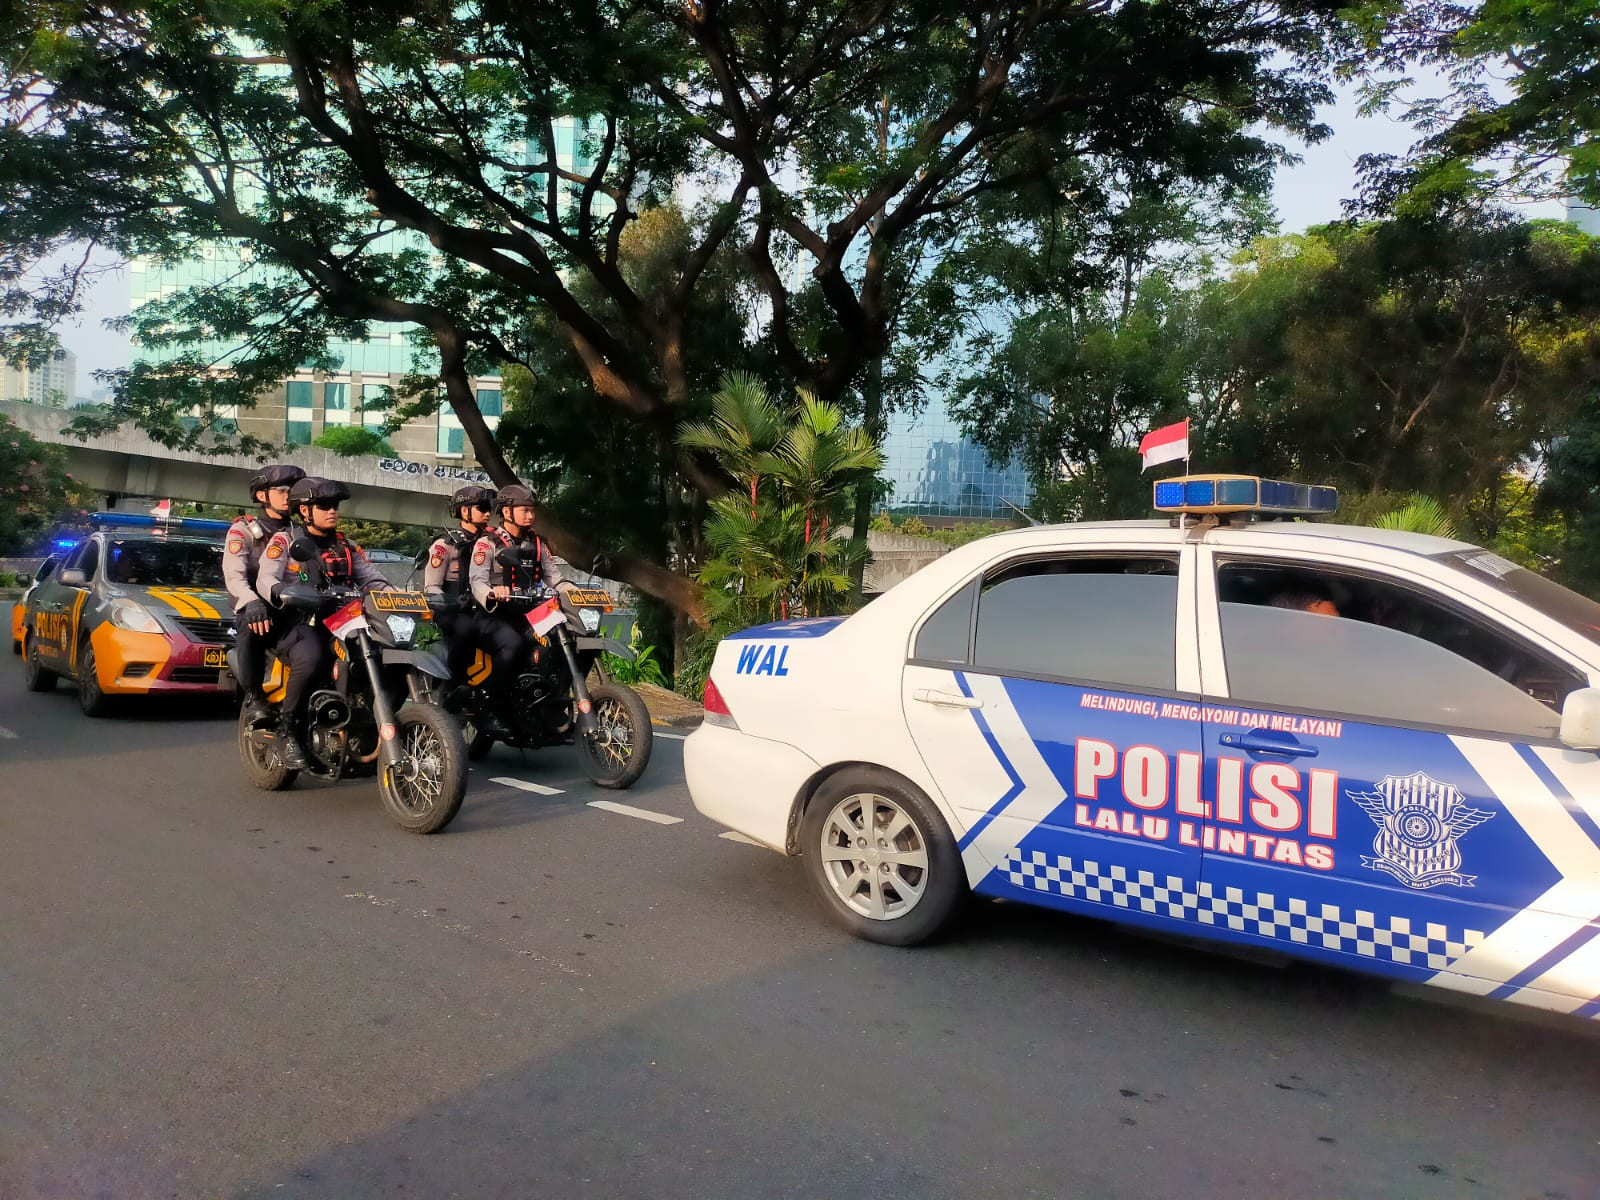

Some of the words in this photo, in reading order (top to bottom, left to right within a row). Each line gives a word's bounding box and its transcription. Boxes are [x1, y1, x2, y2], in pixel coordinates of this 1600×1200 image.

[736, 645, 789, 676] WAL
[1081, 694, 1158, 719] MELINDUNGI,
[1161, 703, 1238, 725] MENGAYOMI
[1241, 713, 1269, 729] DAN
[1271, 717, 1342, 738] MELAYANI
[1074, 736, 1338, 839] POLISI
[1075, 803, 1169, 840] LALU
[1179, 821, 1334, 870] LINTAS
